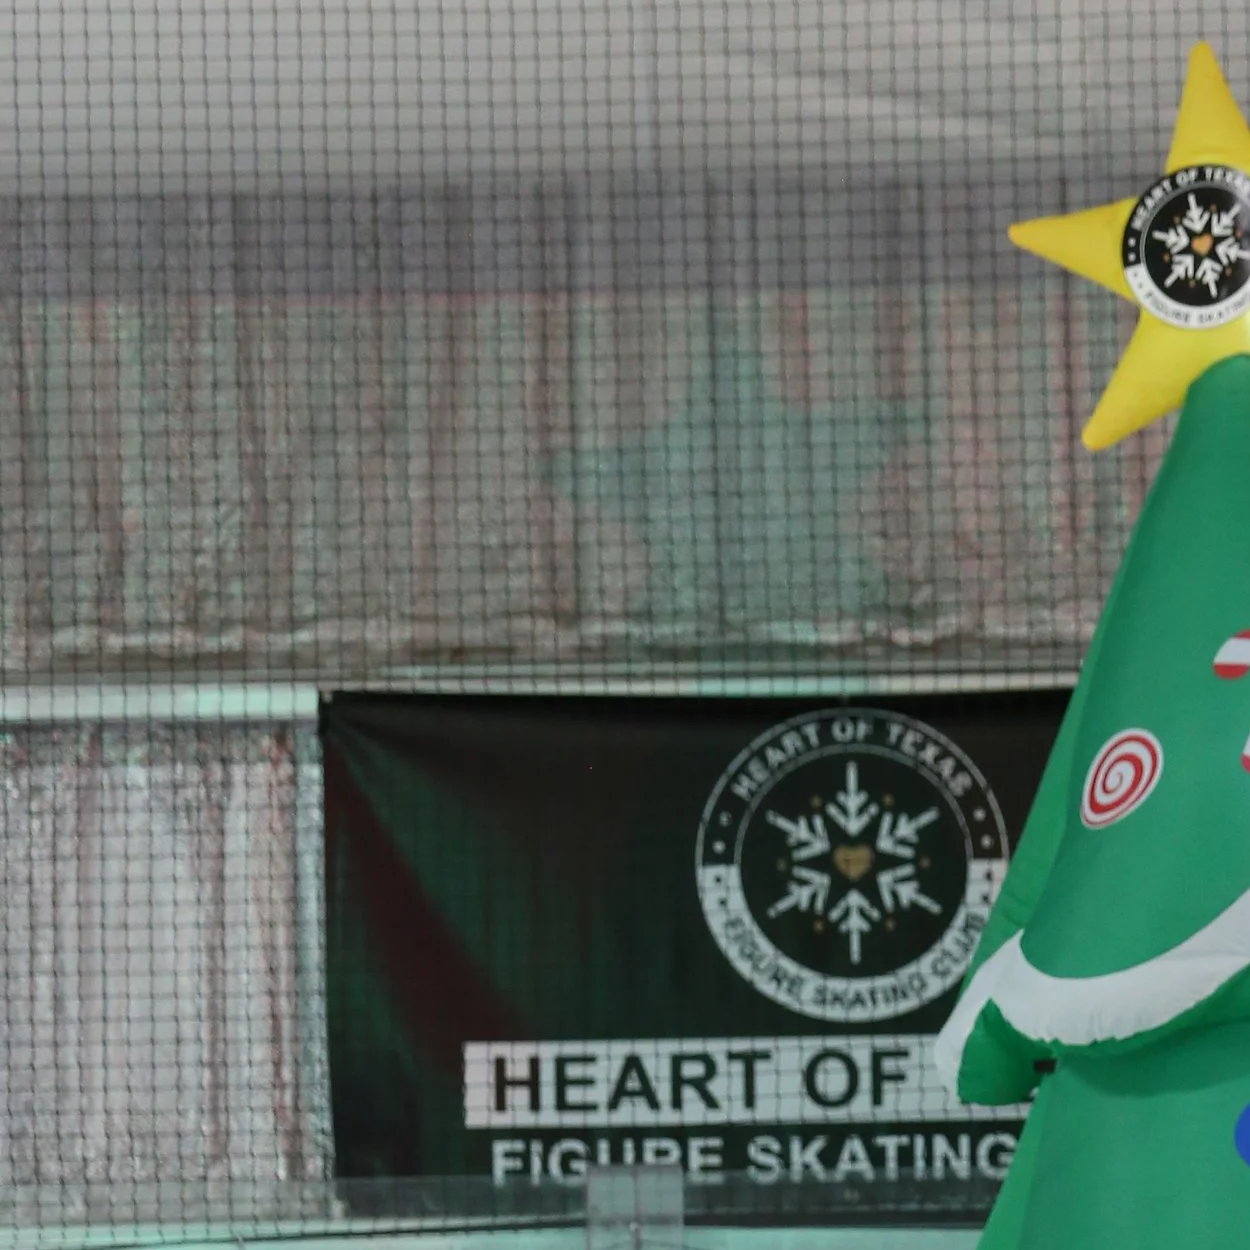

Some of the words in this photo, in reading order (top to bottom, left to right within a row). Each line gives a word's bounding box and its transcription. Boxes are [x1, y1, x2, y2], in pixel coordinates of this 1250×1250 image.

[731, 722, 823, 800] HEART
[831, 718, 873, 743] OF
[886, 721, 973, 797] TEXAS
[812, 971, 928, 1008] SKATING
[930, 911, 985, 977] CLUB
[493, 1049, 771, 1114] HEART
[803, 1046, 911, 1108] OF
[747, 1132, 1017, 1185] SKATING
